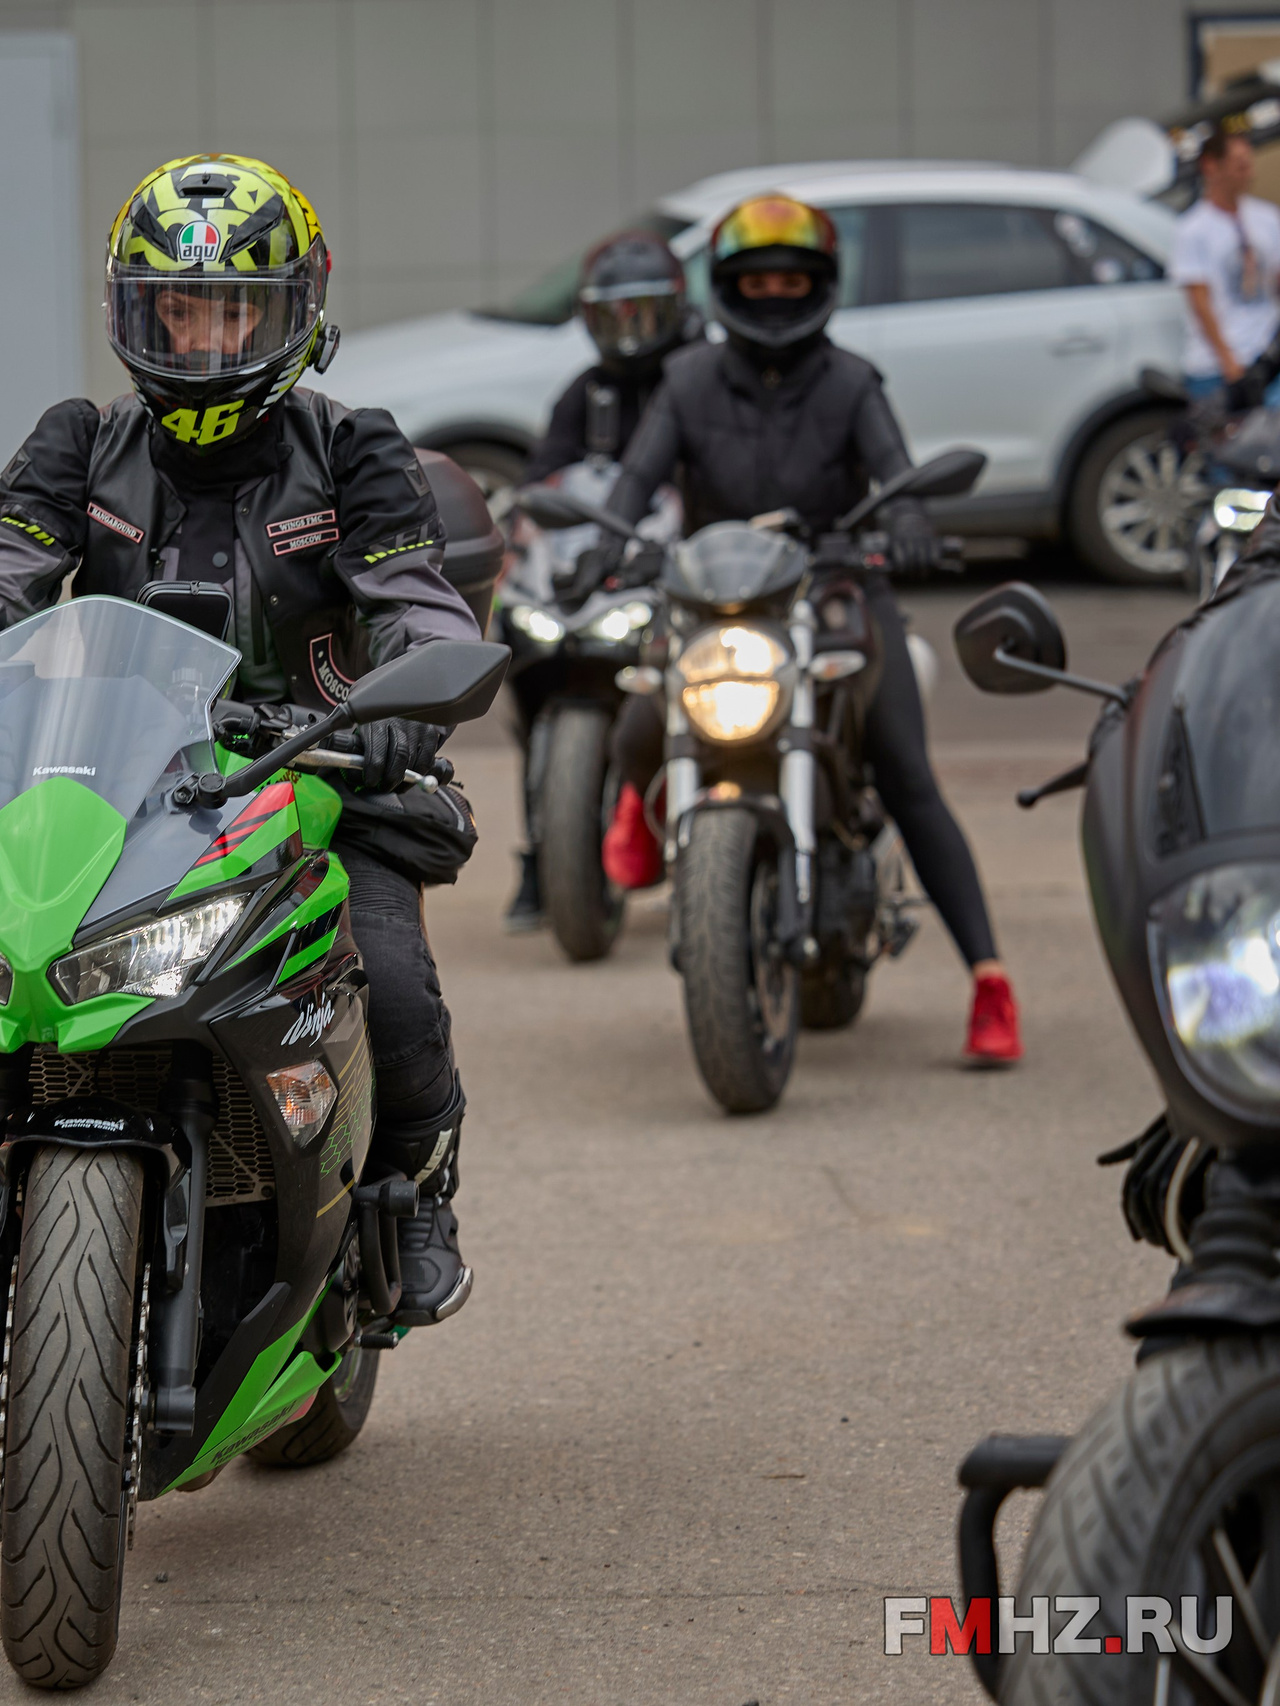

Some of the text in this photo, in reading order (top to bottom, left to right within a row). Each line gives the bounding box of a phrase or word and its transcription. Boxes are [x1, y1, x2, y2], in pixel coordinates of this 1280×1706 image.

[183, 245, 215, 262] agv
[161, 399, 245, 446] 46
[91, 507, 137, 538] HANGAROUND
[279, 514, 323, 531] WINGS FMC
[289, 533, 322, 549] MOSCOW
[318, 660, 350, 702] MOSCO
[32, 765, 97, 777] Kawasaki
[280, 991, 336, 1048] Ninja
[209, 1399, 297, 1466] Kawasaki
